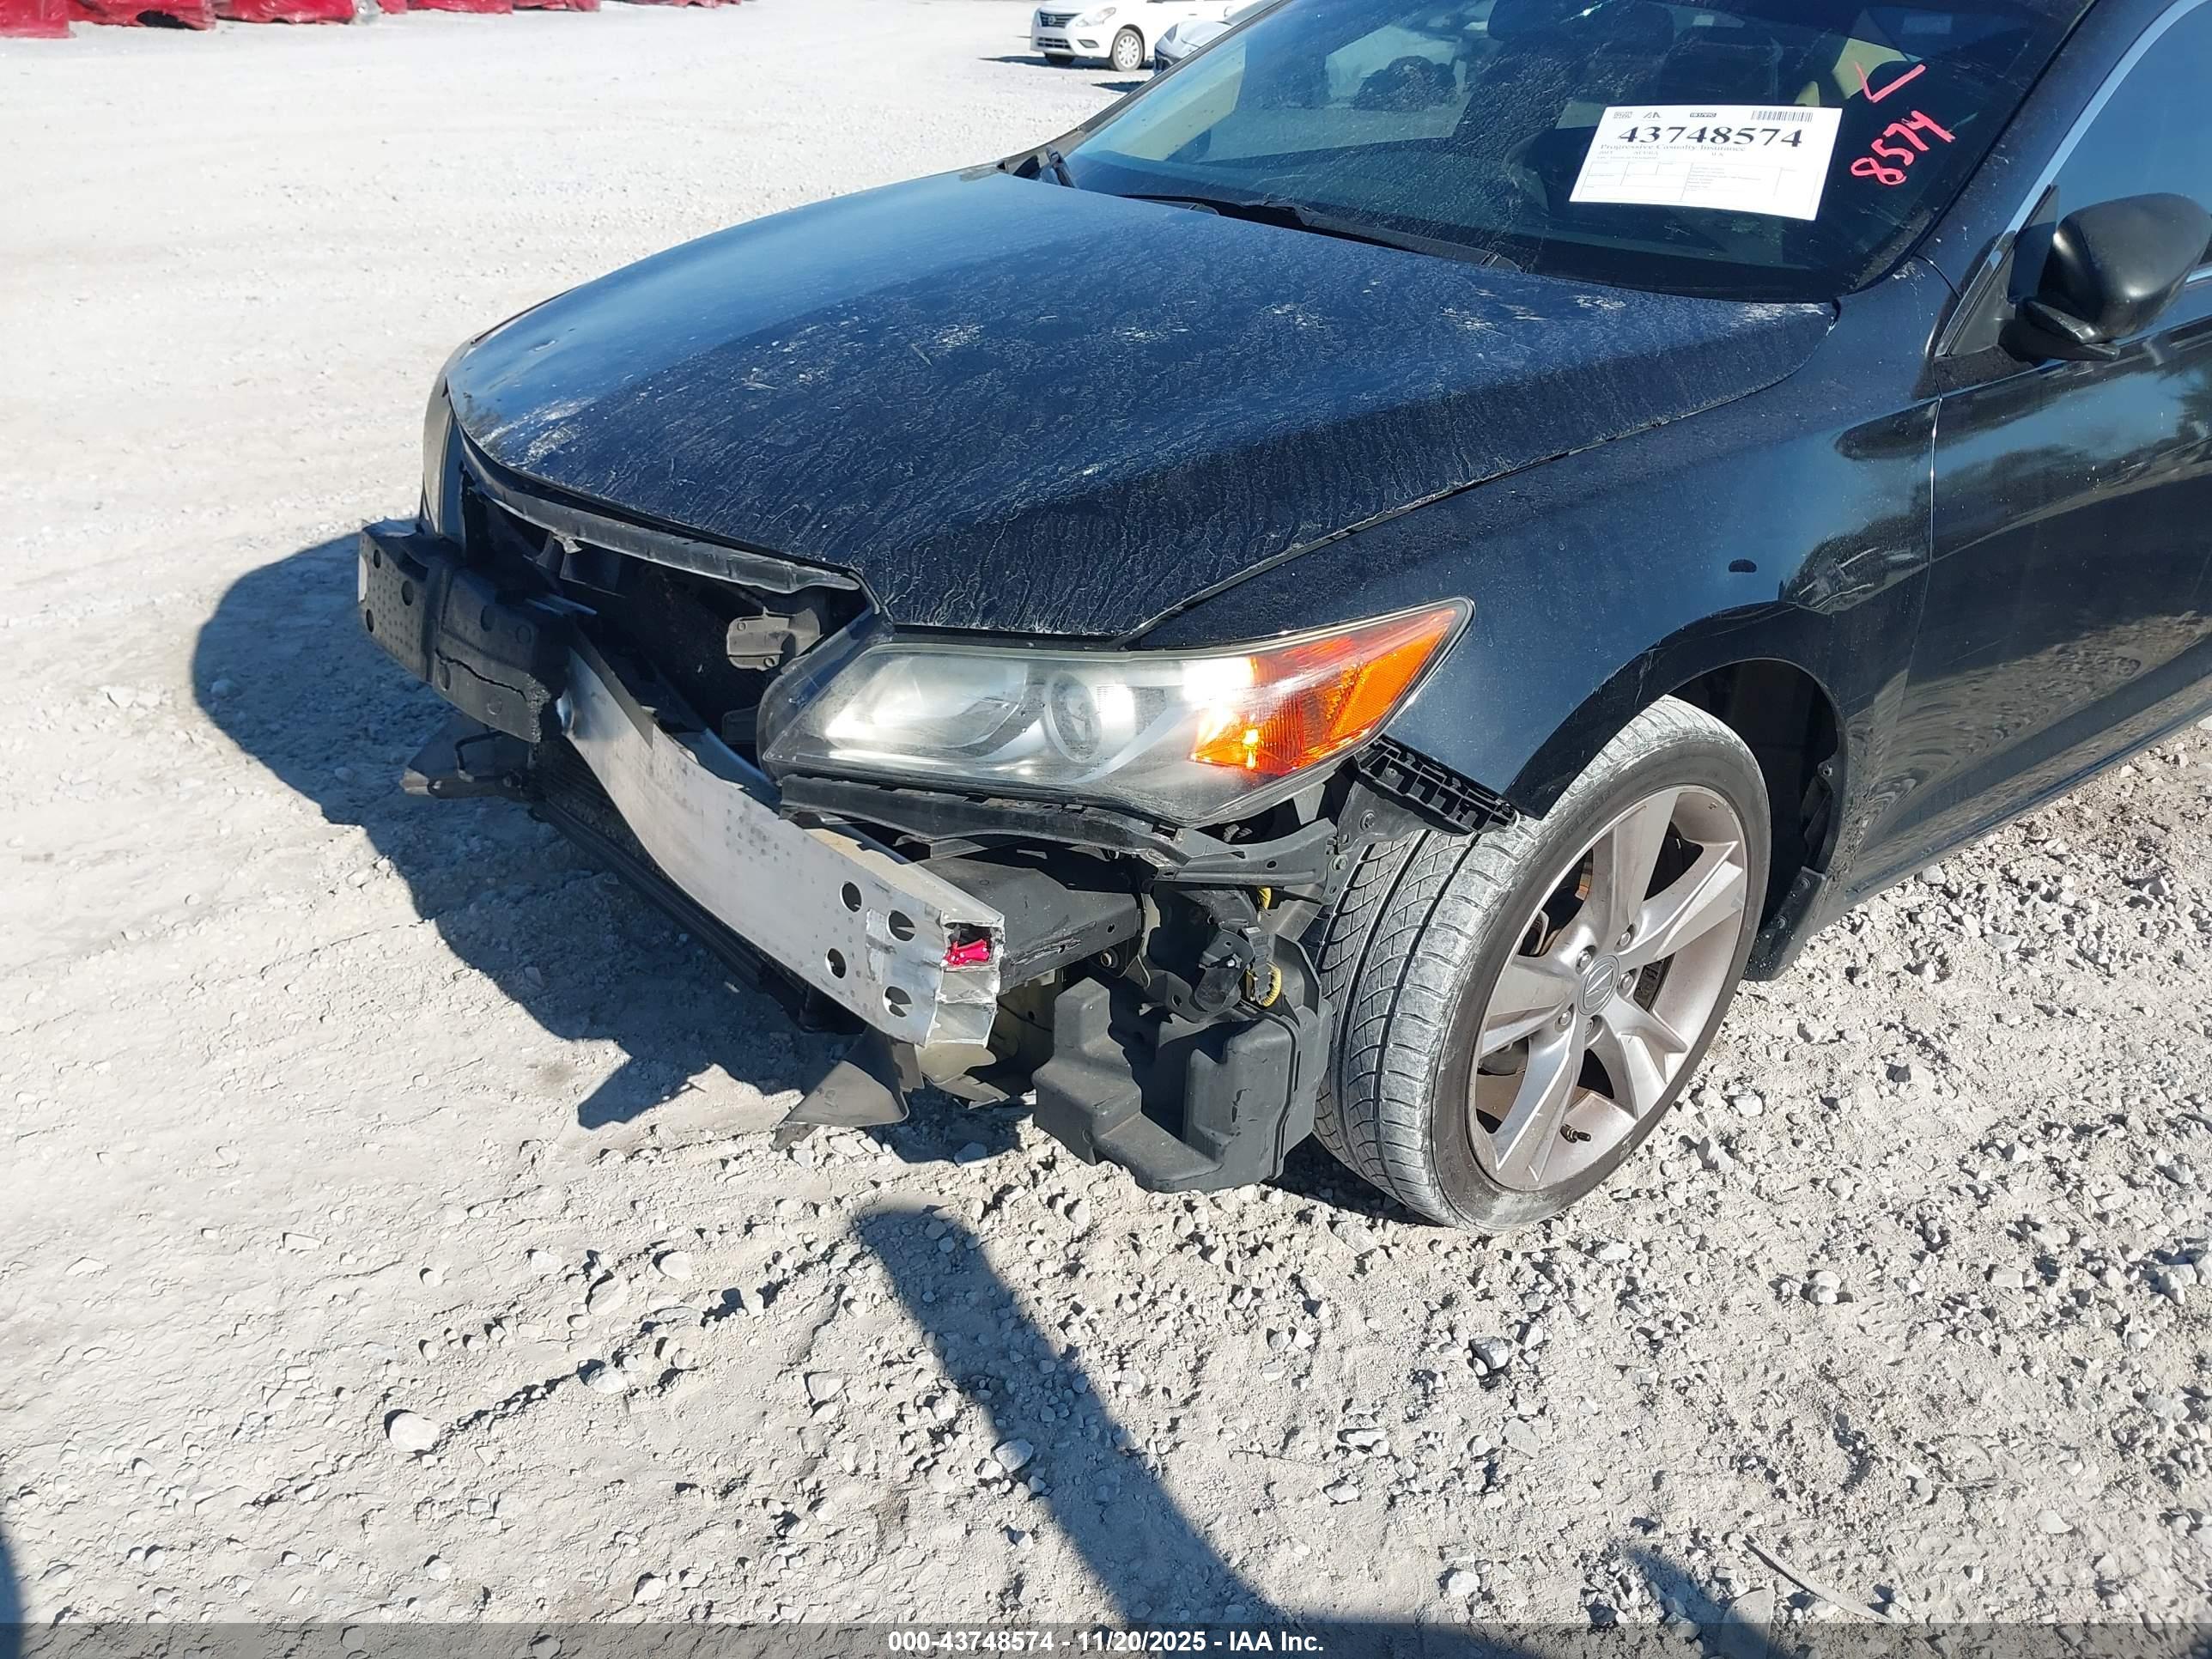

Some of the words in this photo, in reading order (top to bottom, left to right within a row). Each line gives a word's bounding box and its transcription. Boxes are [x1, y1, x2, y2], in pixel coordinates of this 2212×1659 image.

[1600, 143, 1655, 152] Progressive
[1700, 144, 1746, 153] Insurance
[1617, 125, 1802, 148] 43748574
[1850, 109, 1956, 185] 8574
